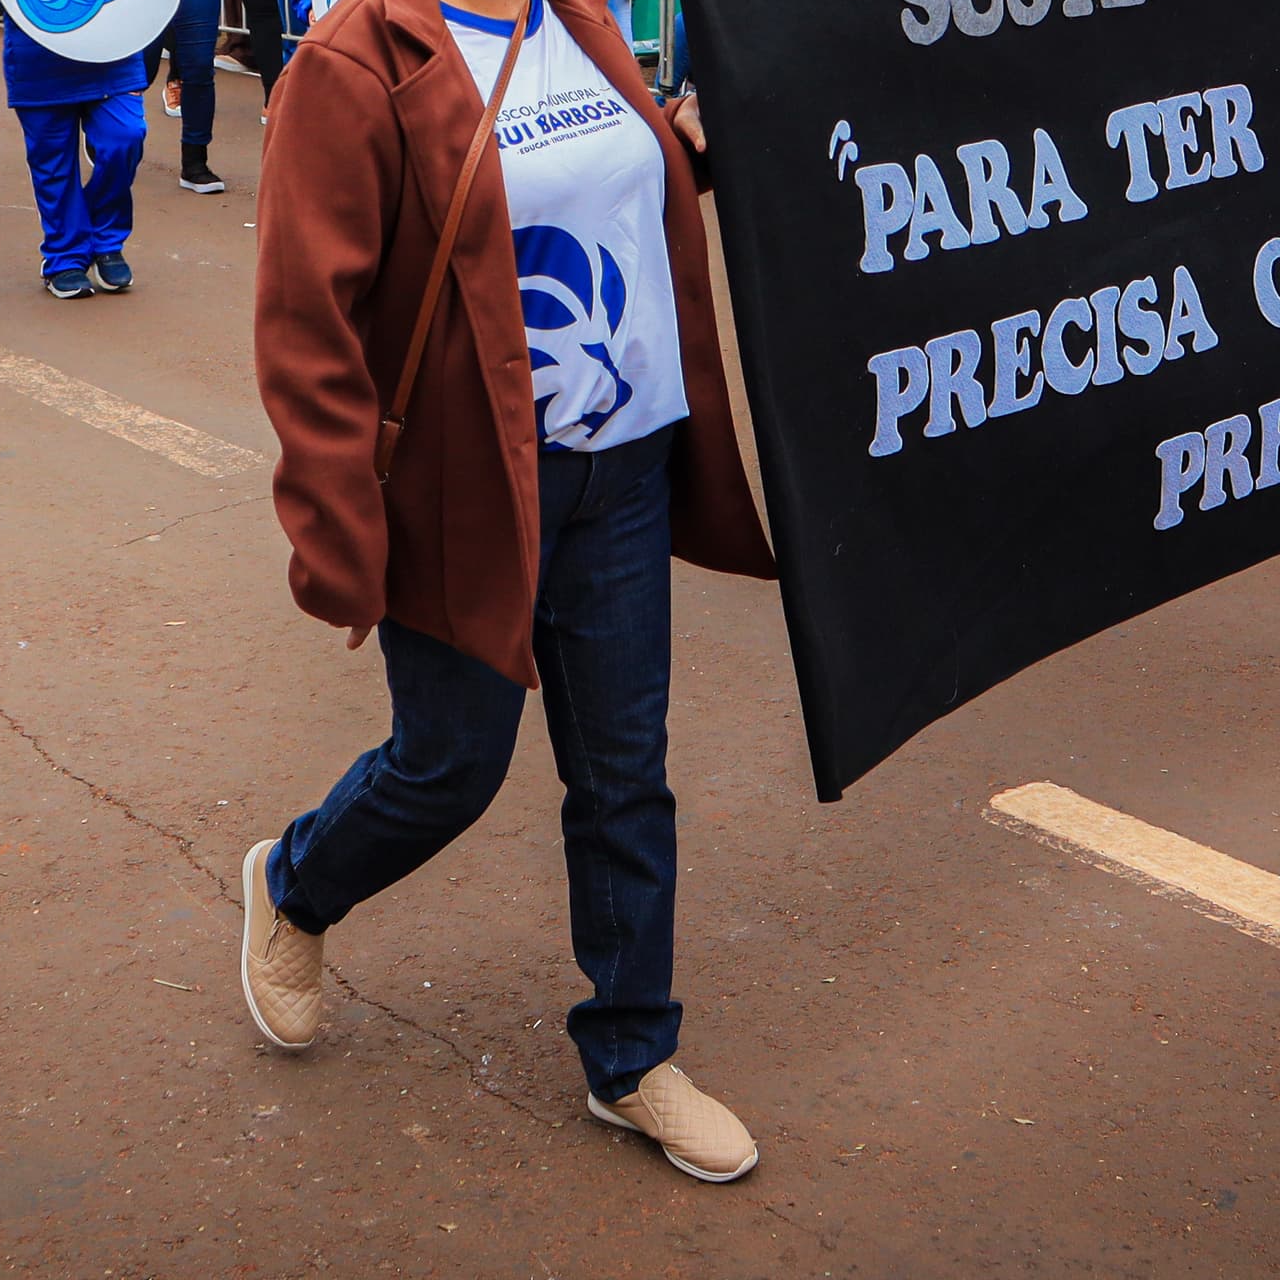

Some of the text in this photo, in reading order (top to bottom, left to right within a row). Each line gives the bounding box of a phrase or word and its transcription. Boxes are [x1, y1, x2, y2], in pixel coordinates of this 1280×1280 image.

[535, 99, 628, 134] BARBOSA
[1106, 84, 1264, 202] TER
[867, 265, 1218, 456] PRECISA
